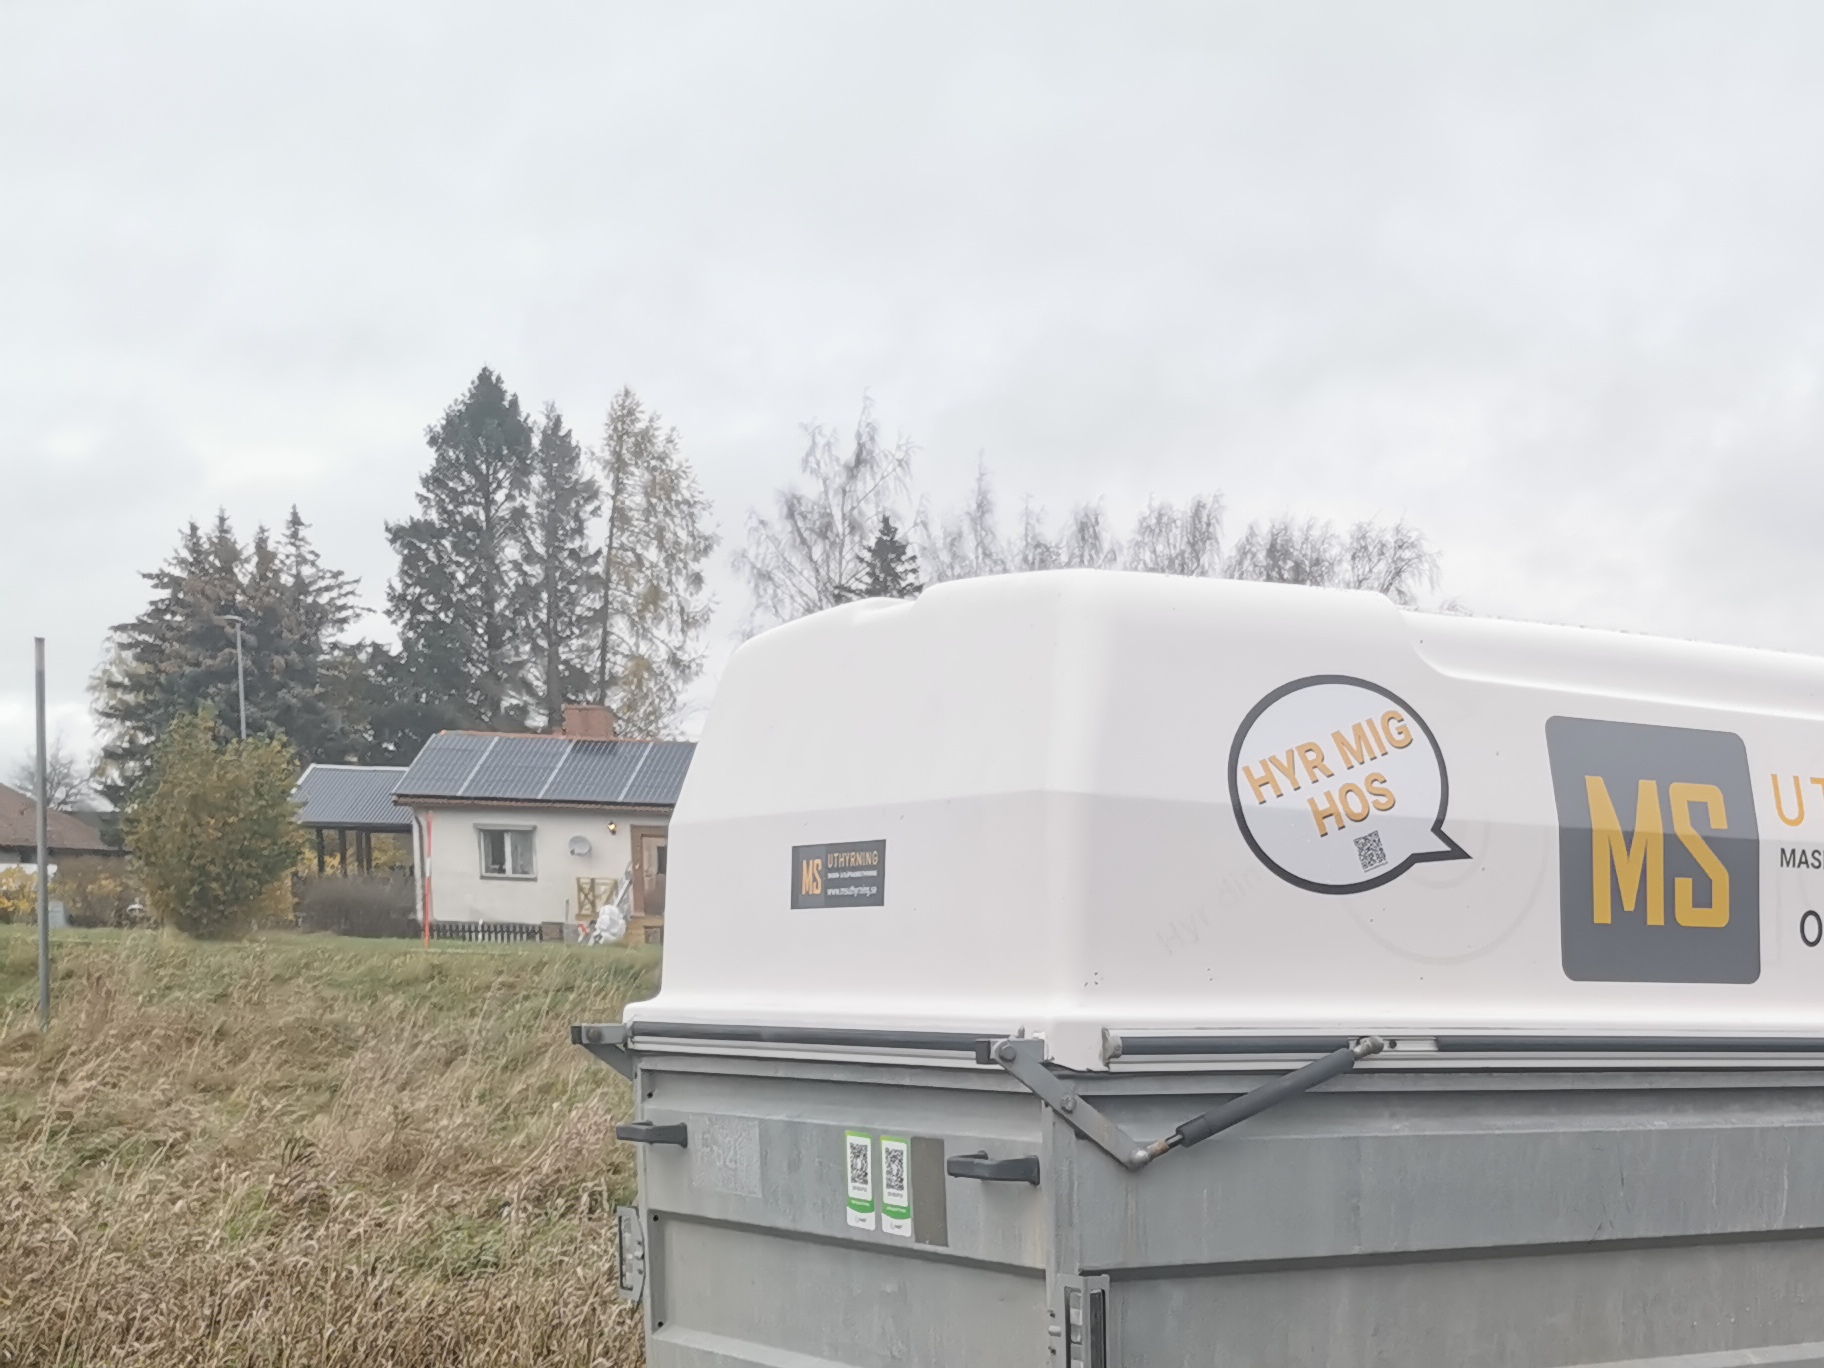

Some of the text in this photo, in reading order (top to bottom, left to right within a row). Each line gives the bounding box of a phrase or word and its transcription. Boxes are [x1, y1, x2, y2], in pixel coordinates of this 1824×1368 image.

[1242, 709, 1414, 805] HYR MIG
[1306, 772, 1396, 837] HOS
[801, 858, 823, 896] MS
[828, 851, 879, 868] UTHYRNING
[1584, 775, 1730, 928] MS
